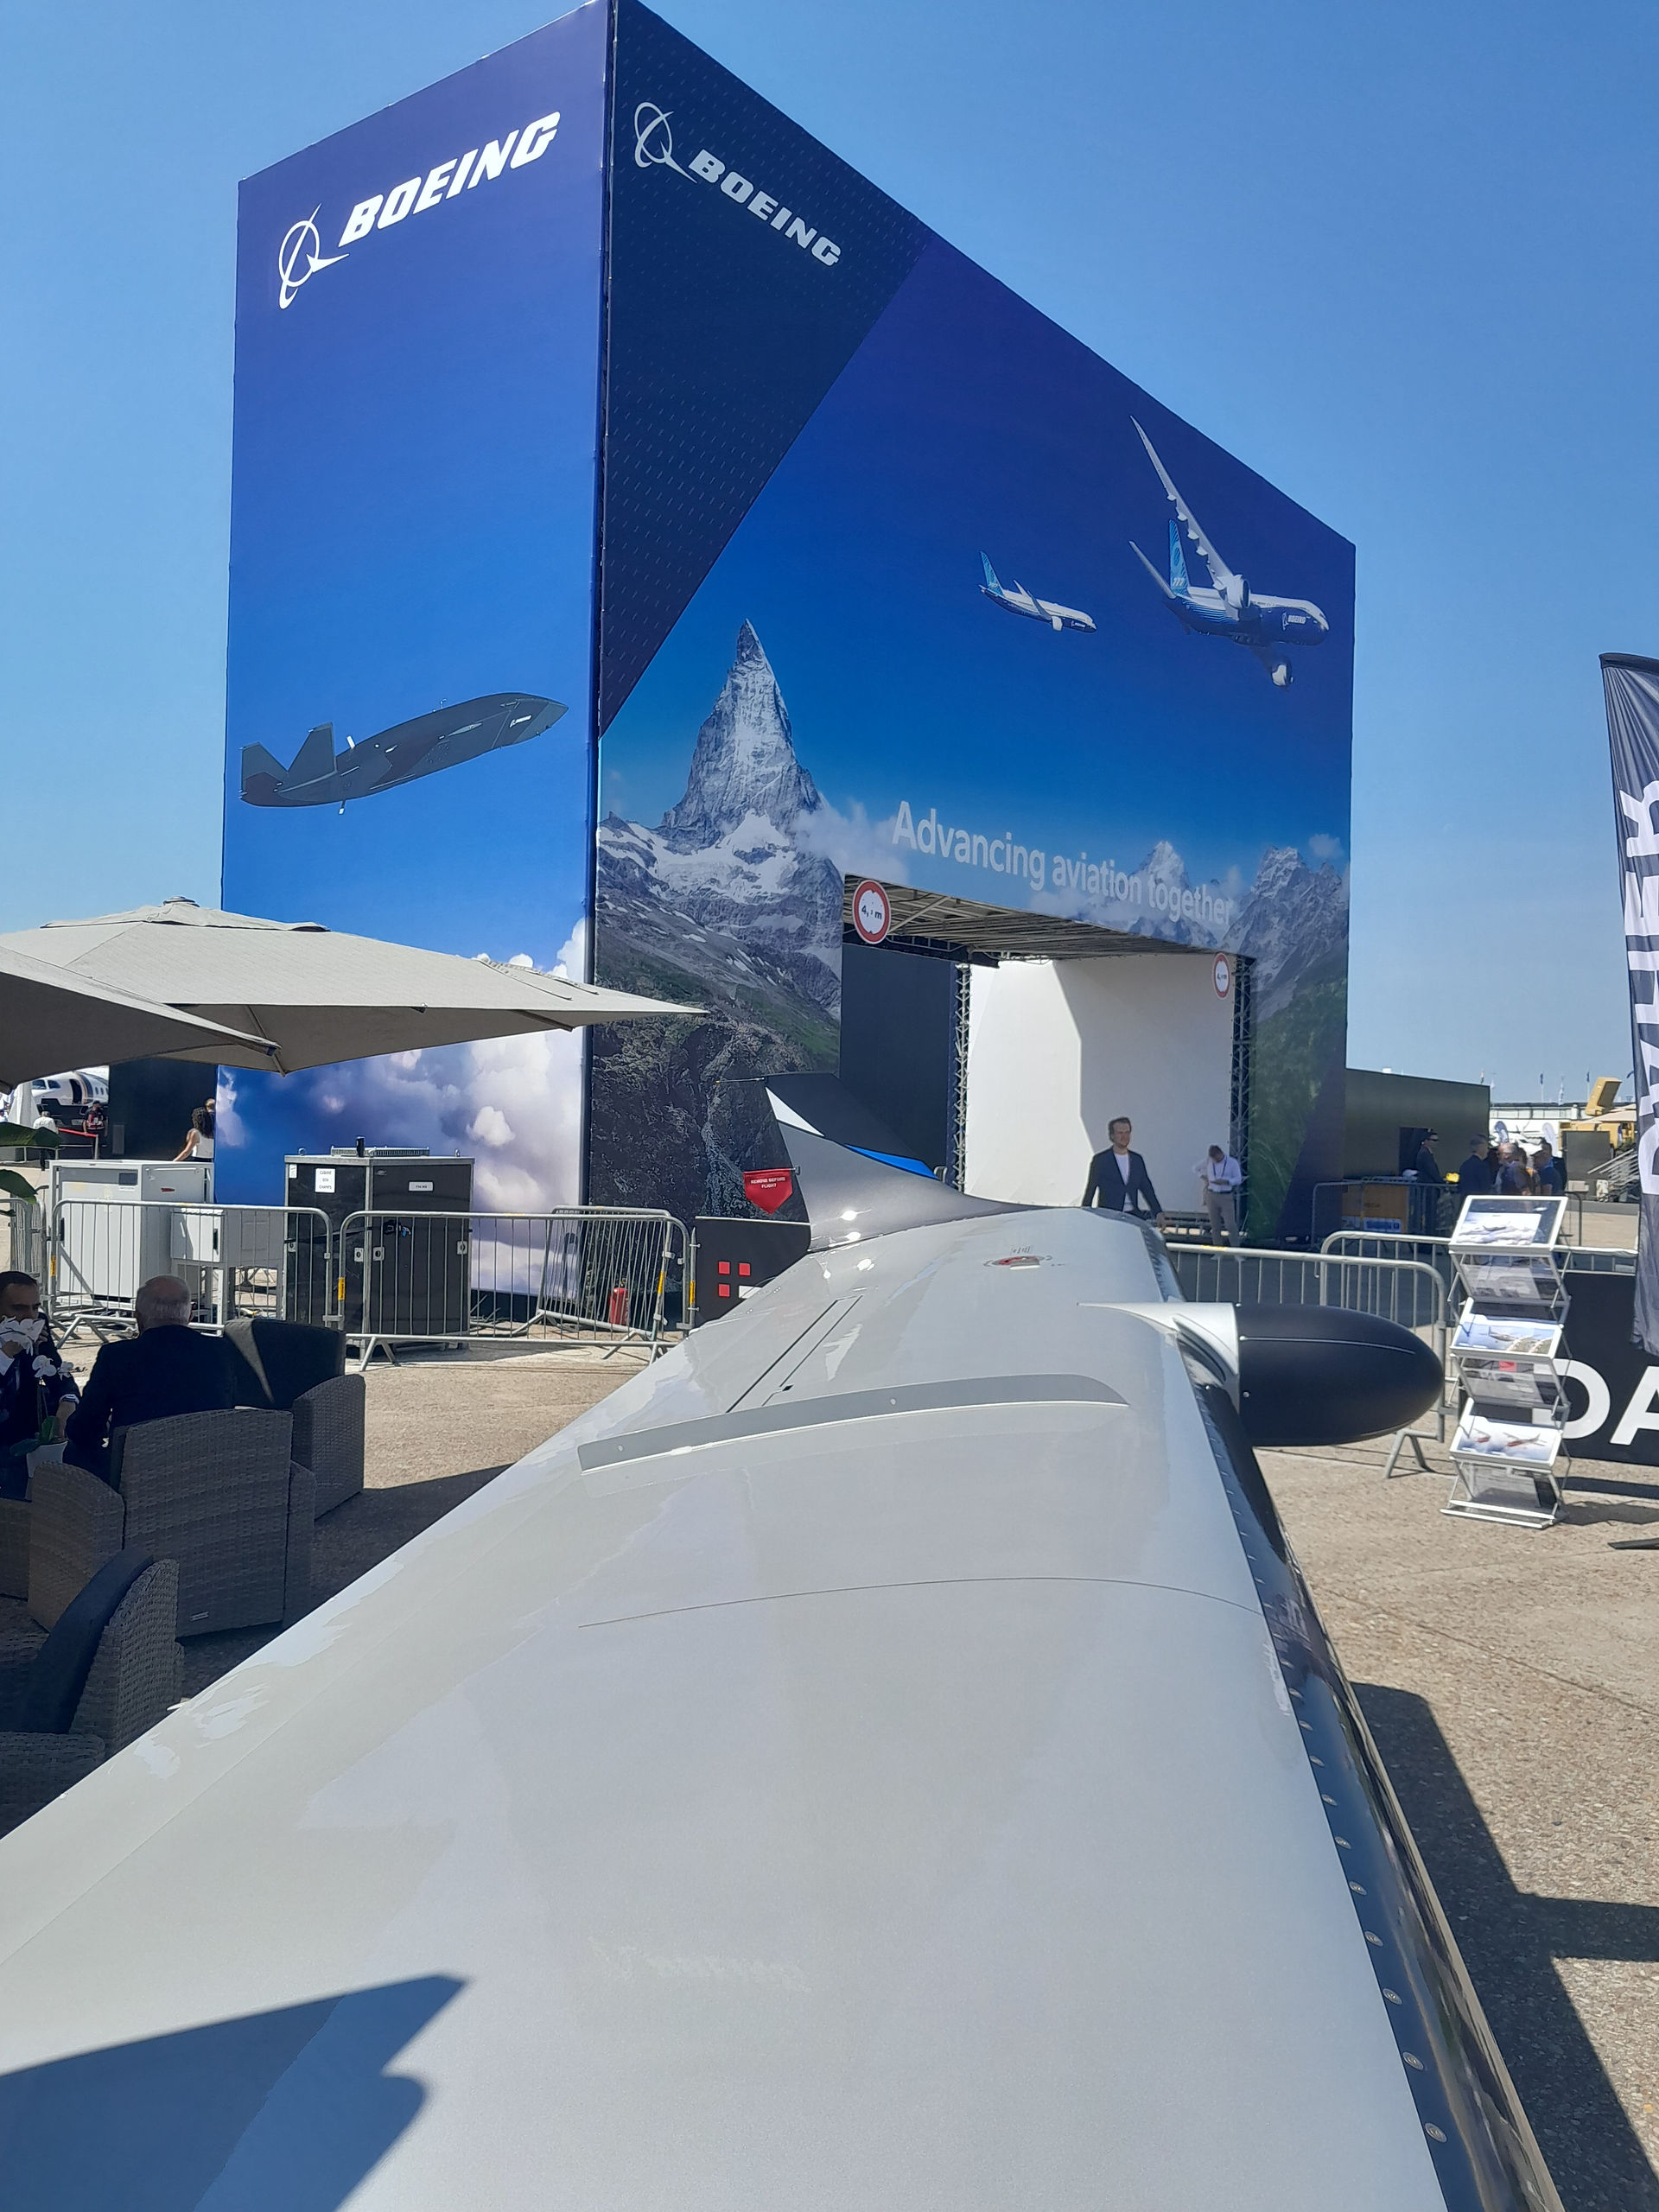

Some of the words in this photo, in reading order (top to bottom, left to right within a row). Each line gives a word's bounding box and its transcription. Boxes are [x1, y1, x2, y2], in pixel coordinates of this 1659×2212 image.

[338, 111, 561, 248] BOEING
[688, 149, 842, 267] BOEING
[892, 800, 1046, 891] Advancing
[1052, 852, 1142, 904] aviation
[1147, 873, 1234, 925] together
